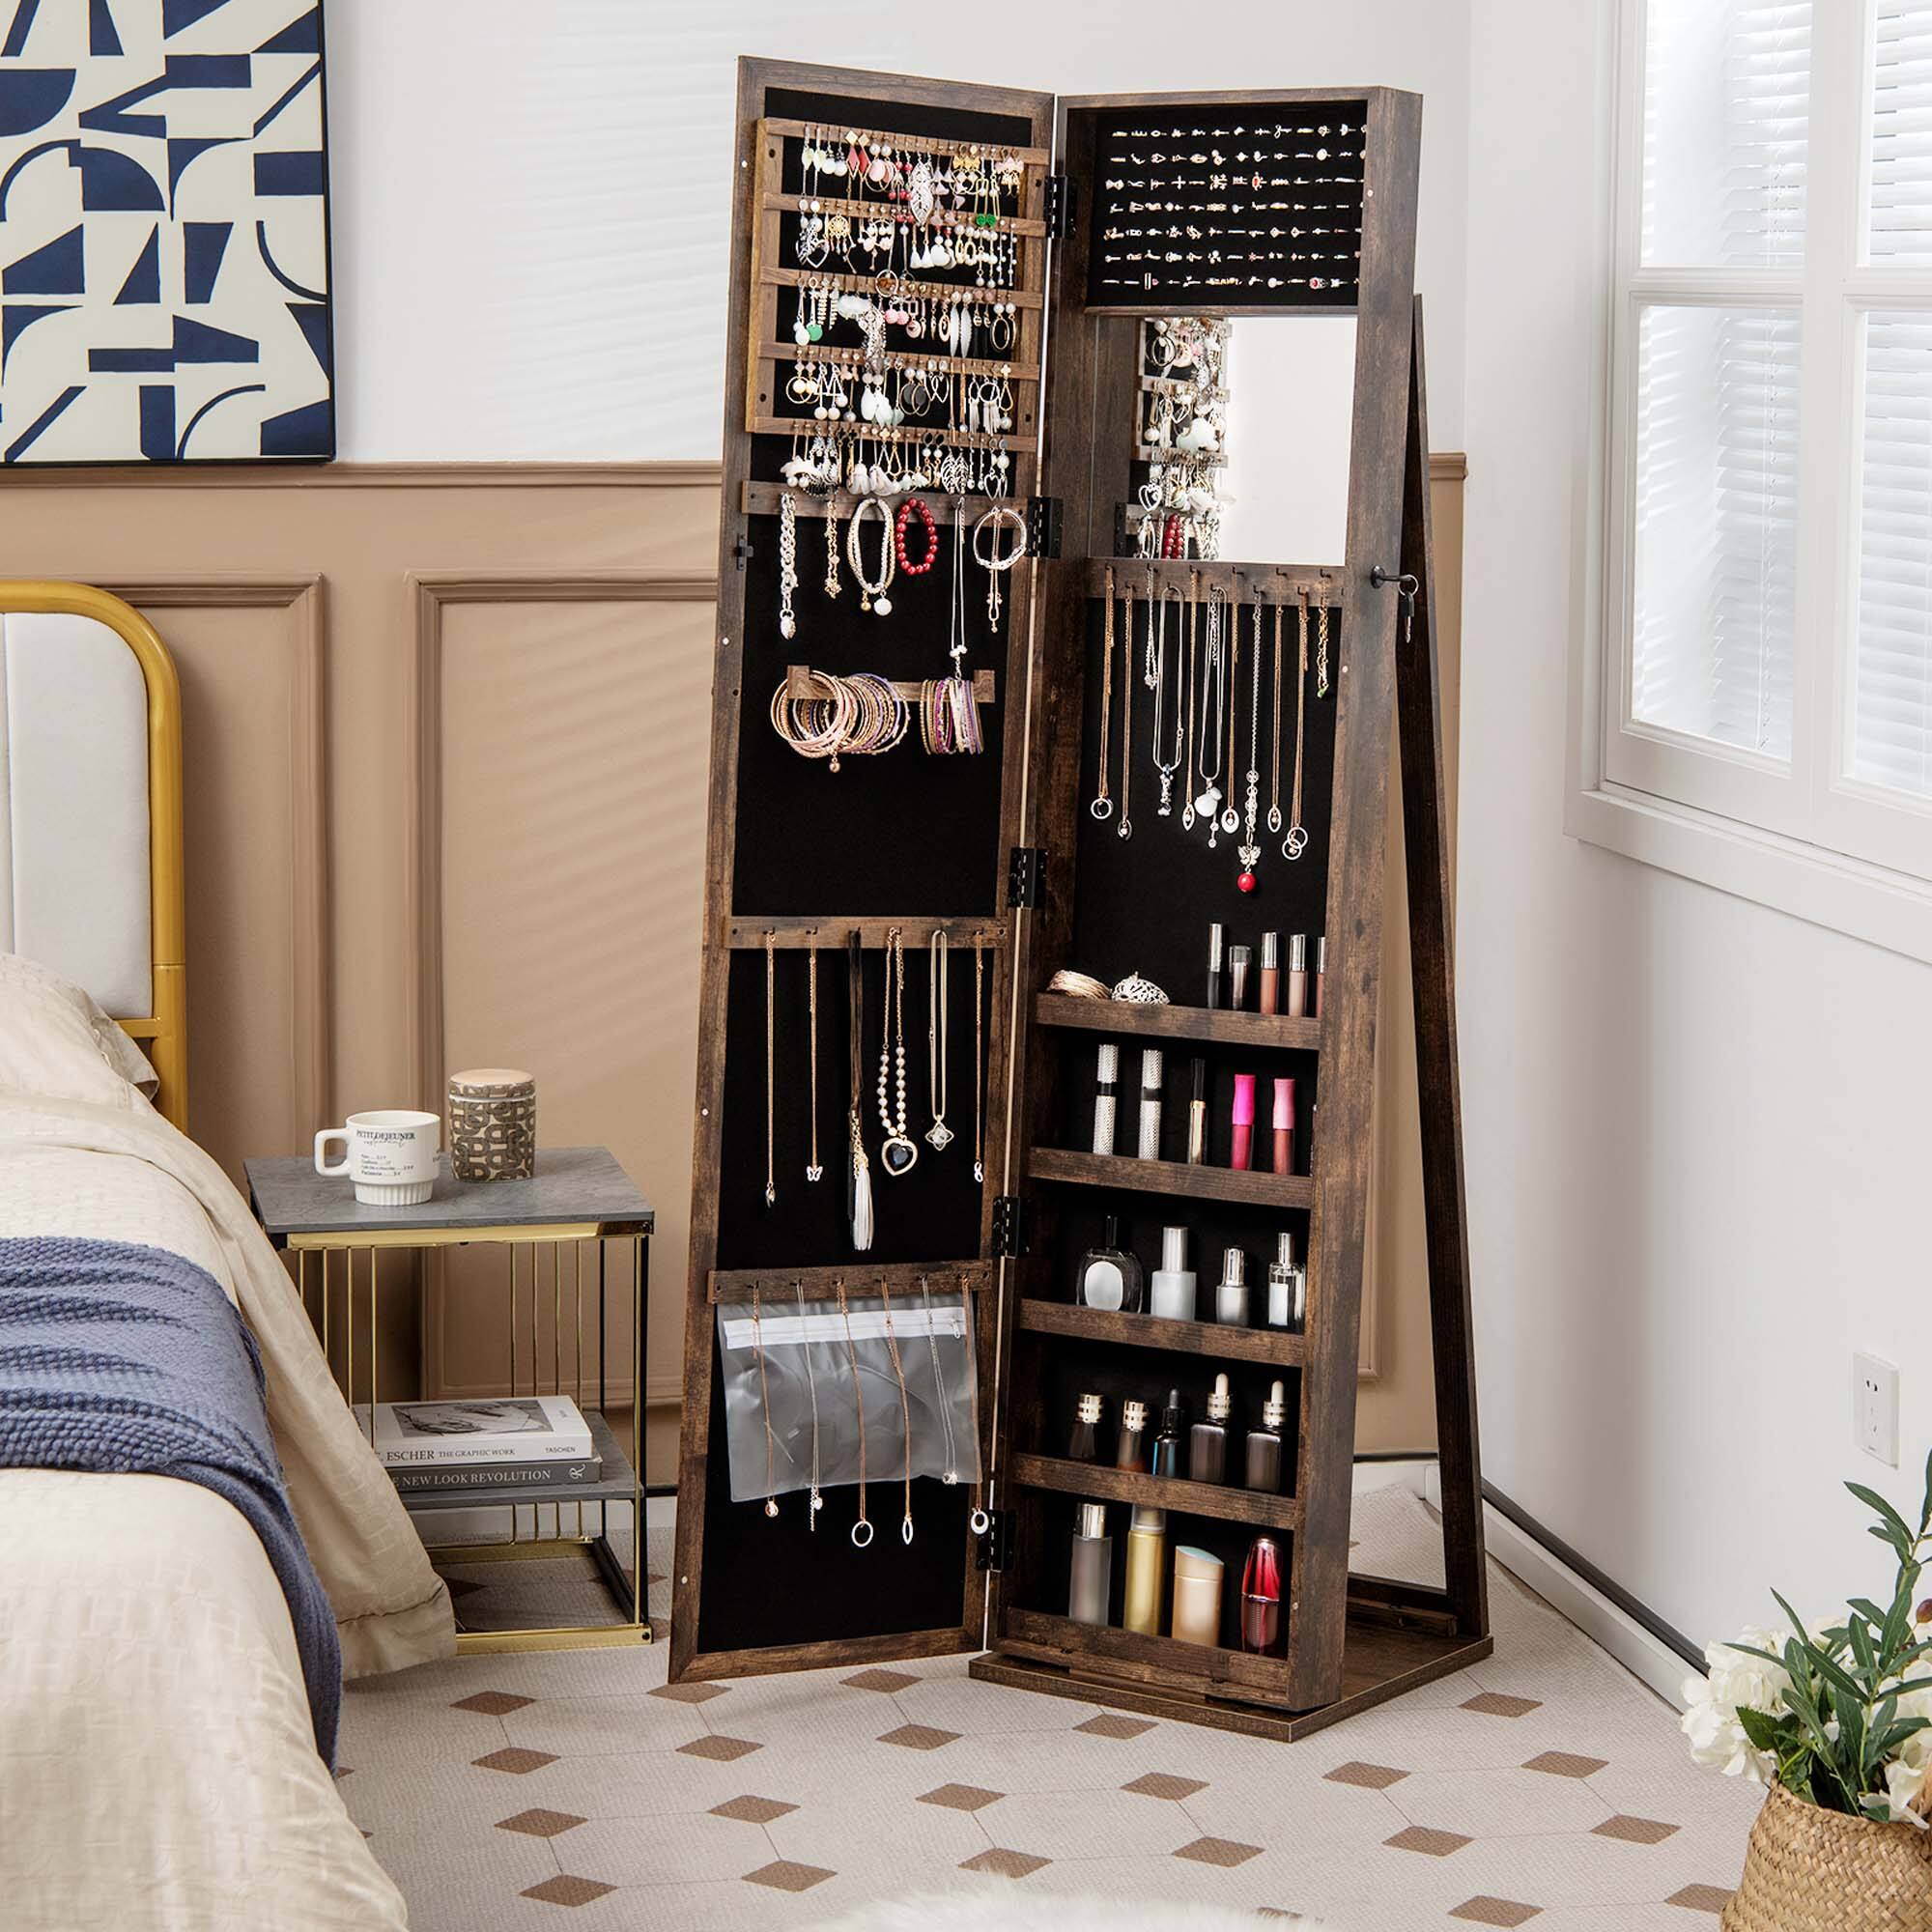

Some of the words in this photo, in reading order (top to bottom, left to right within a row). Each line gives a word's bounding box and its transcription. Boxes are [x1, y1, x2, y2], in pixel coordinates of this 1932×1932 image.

[386, 1450, 435, 1462] ESCHER
[403, 1476, 431, 1486] NEW
[434, 1473, 468, 1485] LOOK
[470, 1470, 551, 1484] REVOLUTION
